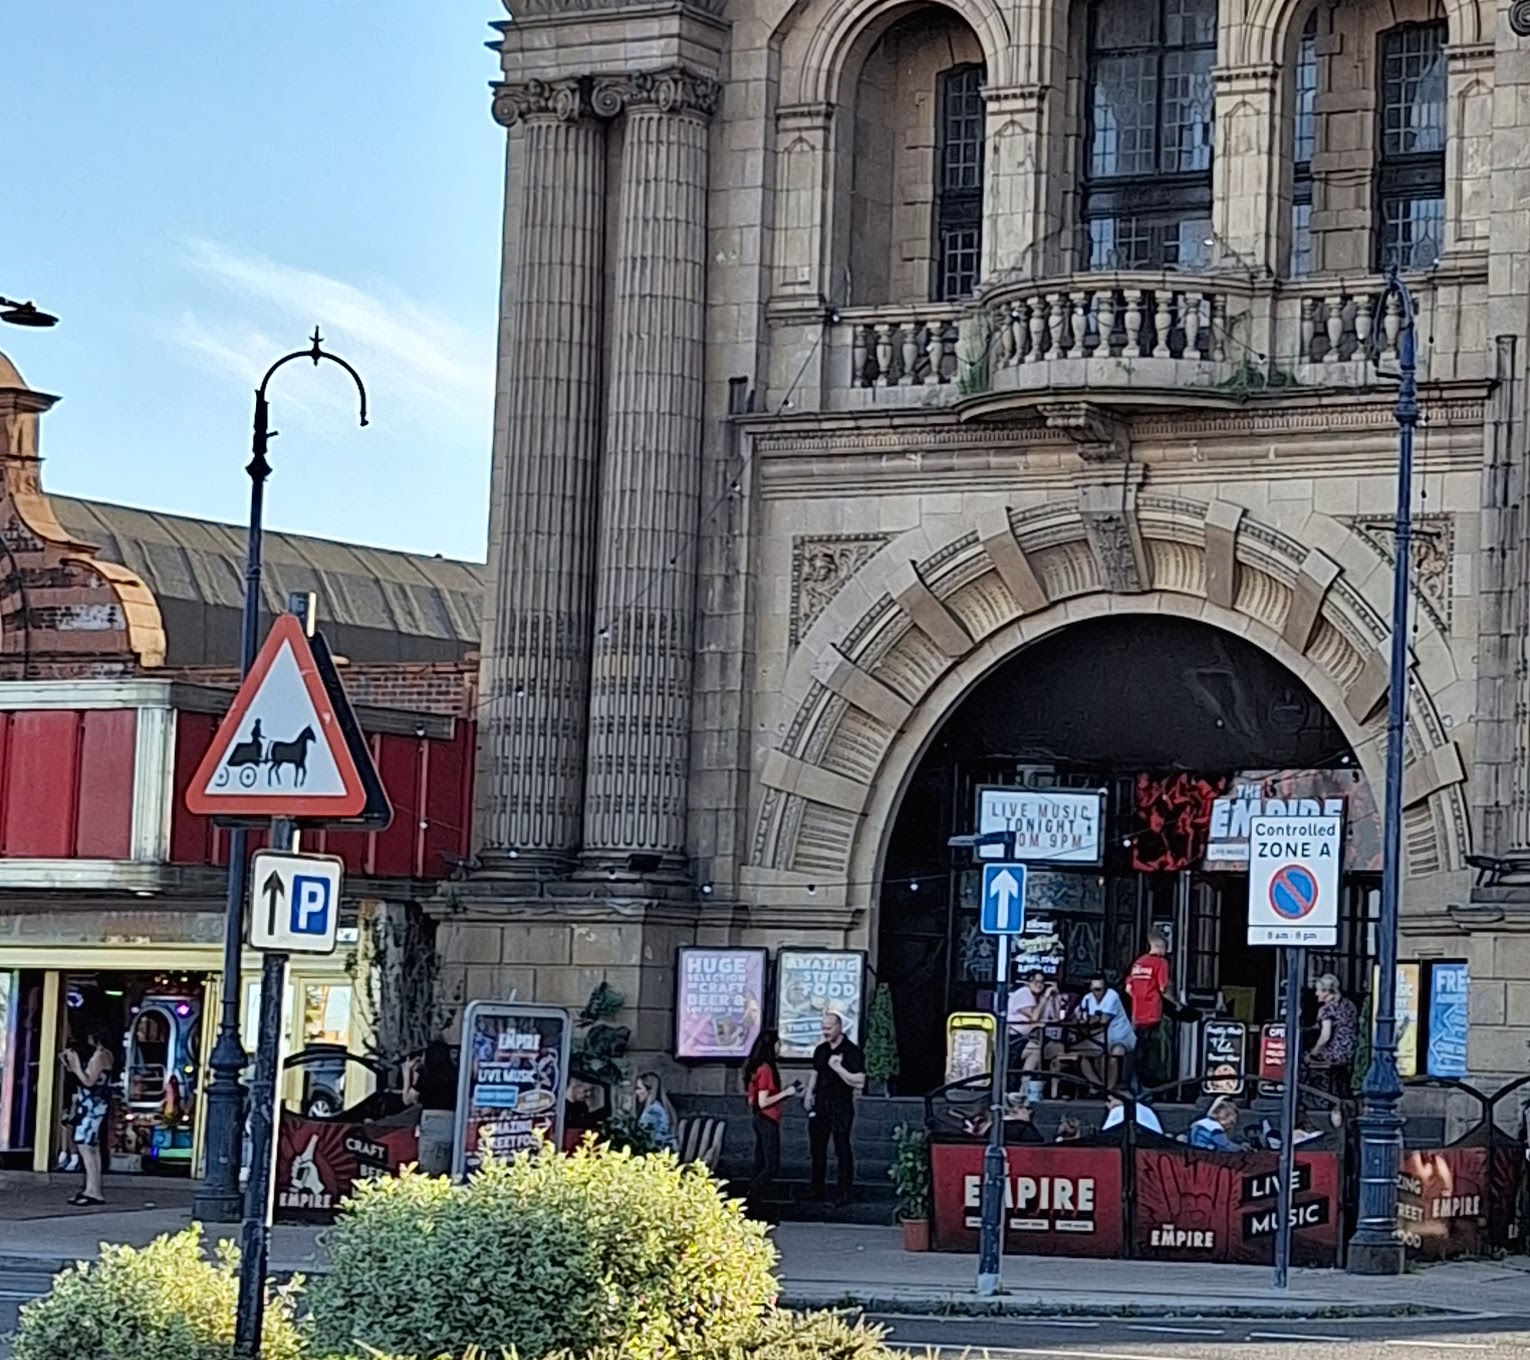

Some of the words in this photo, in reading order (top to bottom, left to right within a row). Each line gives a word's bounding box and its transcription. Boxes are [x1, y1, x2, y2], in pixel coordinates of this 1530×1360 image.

[1236, 783, 1262, 799] THE
[991, 802, 1028, 818] LIVE
[1038, 803, 1089, 820] MUSIC
[1005, 818, 1075, 834] TONIGHT
[1255, 823, 1336, 837] Controlled
[1018, 832, 1039, 848] OM
[1049, 834, 1082, 849] 9PM
[1258, 842, 1311, 858] ZONE
[1319, 842, 1332, 858] A
[298, 880, 326, 931] P
[687, 957, 747, 974] HUGE
[785, 957, 858, 971] AMAZING
[687, 973, 746, 982] SELECTION
[803, 970, 856, 983] STREET
[699, 982, 744, 994] CRAFT
[803, 982, 856, 998] FOOD
[687, 994, 730, 1007] BEER
[733, 994, 745, 1007] &
[478, 1069, 501, 1083] LIVE
[503, 1068, 536, 1083] MUSIC
[345, 1138, 385, 1159] CRAFT
[280, 1192, 332, 1209] EMPIRE
[1432, 1195, 1480, 1218] EMPIRE
[1151, 1230, 1214, 1248] EMPIRE
